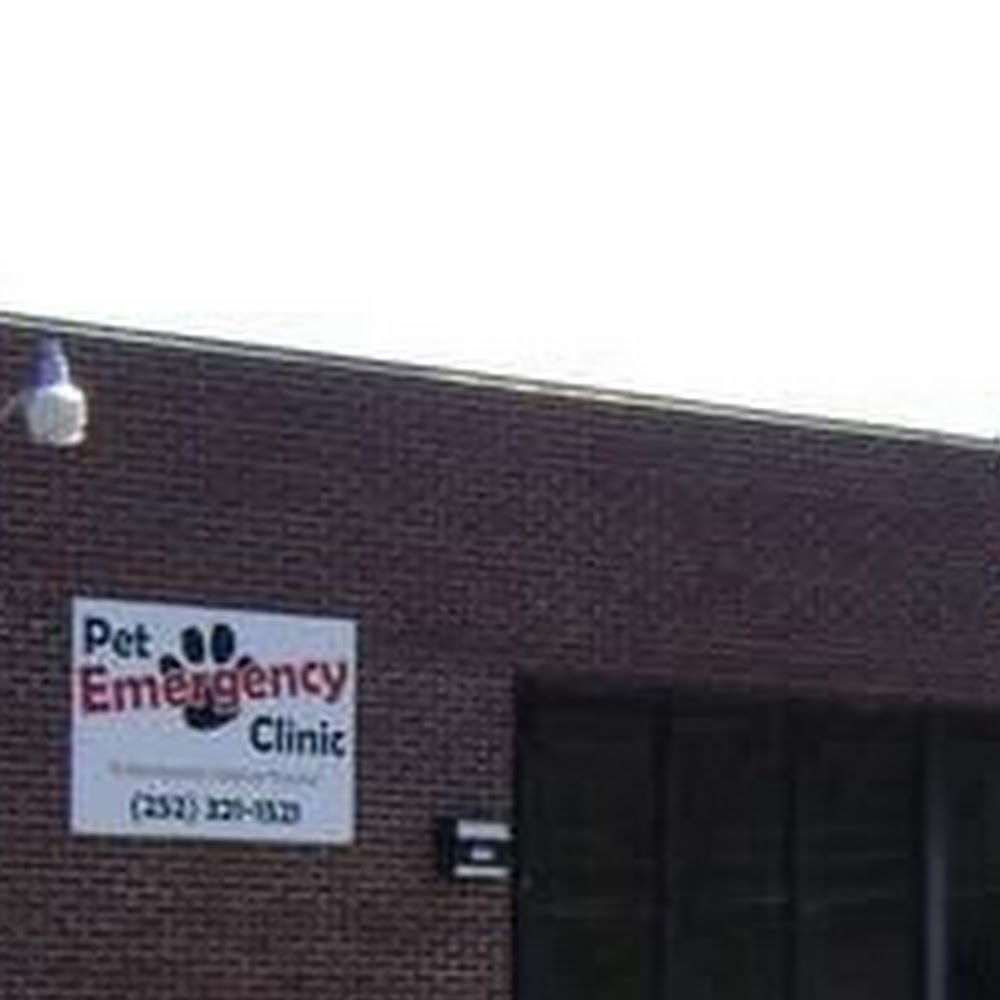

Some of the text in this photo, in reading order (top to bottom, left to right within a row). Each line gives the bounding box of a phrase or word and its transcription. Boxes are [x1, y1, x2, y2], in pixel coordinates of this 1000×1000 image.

[84, 617, 151, 658] Pet
[80, 662, 347, 714] Emergency
[250, 716, 346, 756] Clinic
